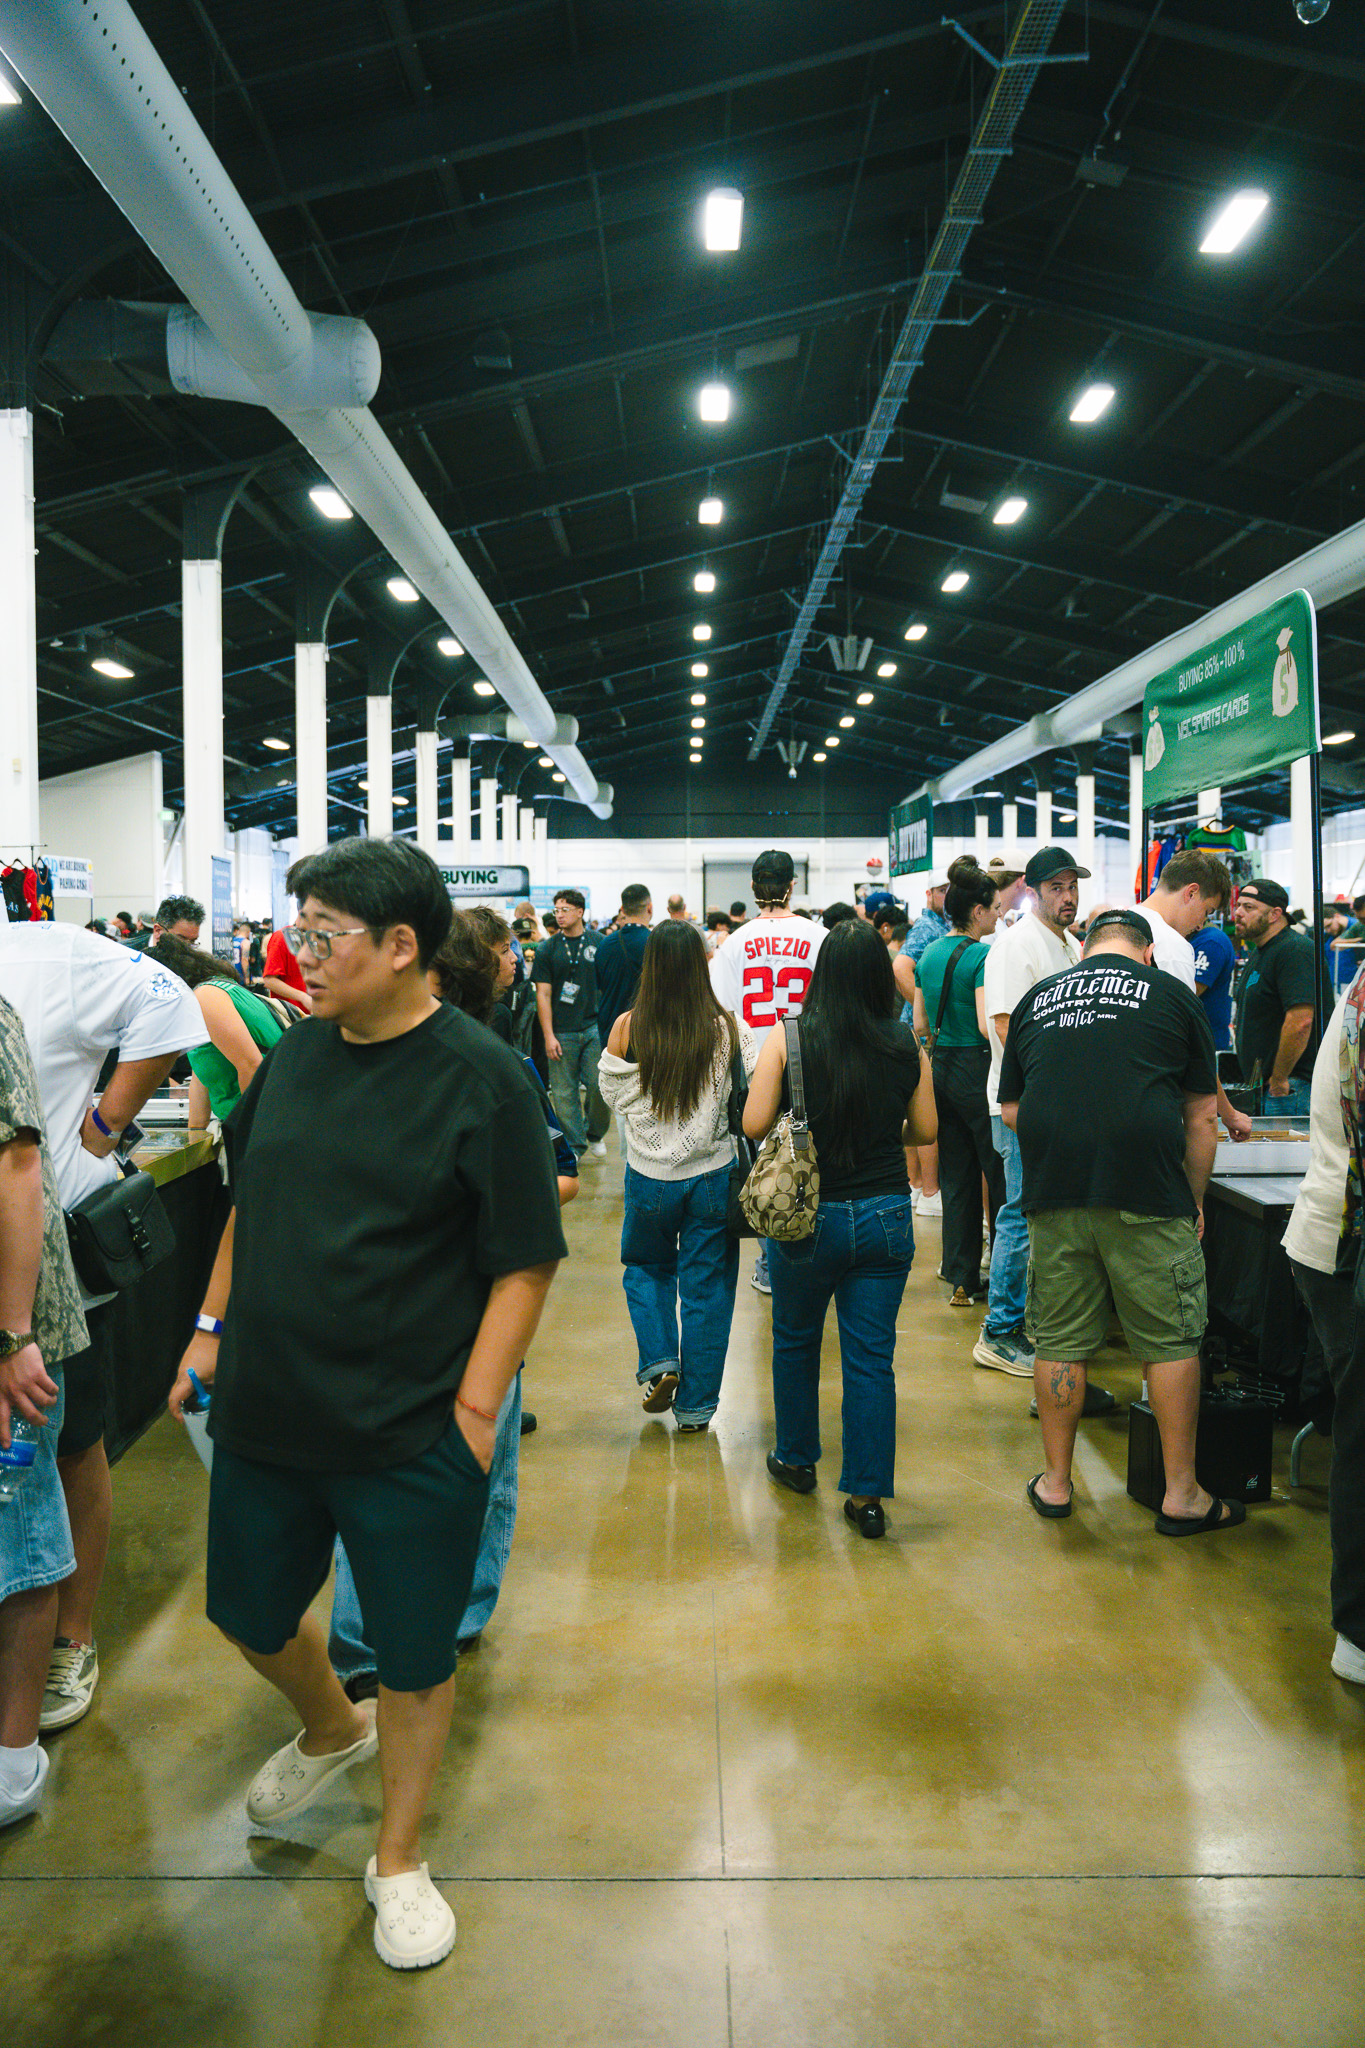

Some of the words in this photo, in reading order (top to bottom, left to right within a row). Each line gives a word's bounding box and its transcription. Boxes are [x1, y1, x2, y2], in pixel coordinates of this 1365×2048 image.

[1178, 663, 1204, 693] BUYING
[1191, 705, 1222, 735] SPORTS
[1221, 693, 1250, 723] CARDS
[440, 870, 498, 884] BUYING
[744, 936, 811, 960] SPIEZIO
[1055, 968, 1133, 985] VIOLENT
[742, 966, 814, 1028] 23
[1032, 997, 1095, 1022] COUNTRY
[1098, 996, 1141, 1010] CLUB
[1097, 1013, 1118, 1021] MRK
